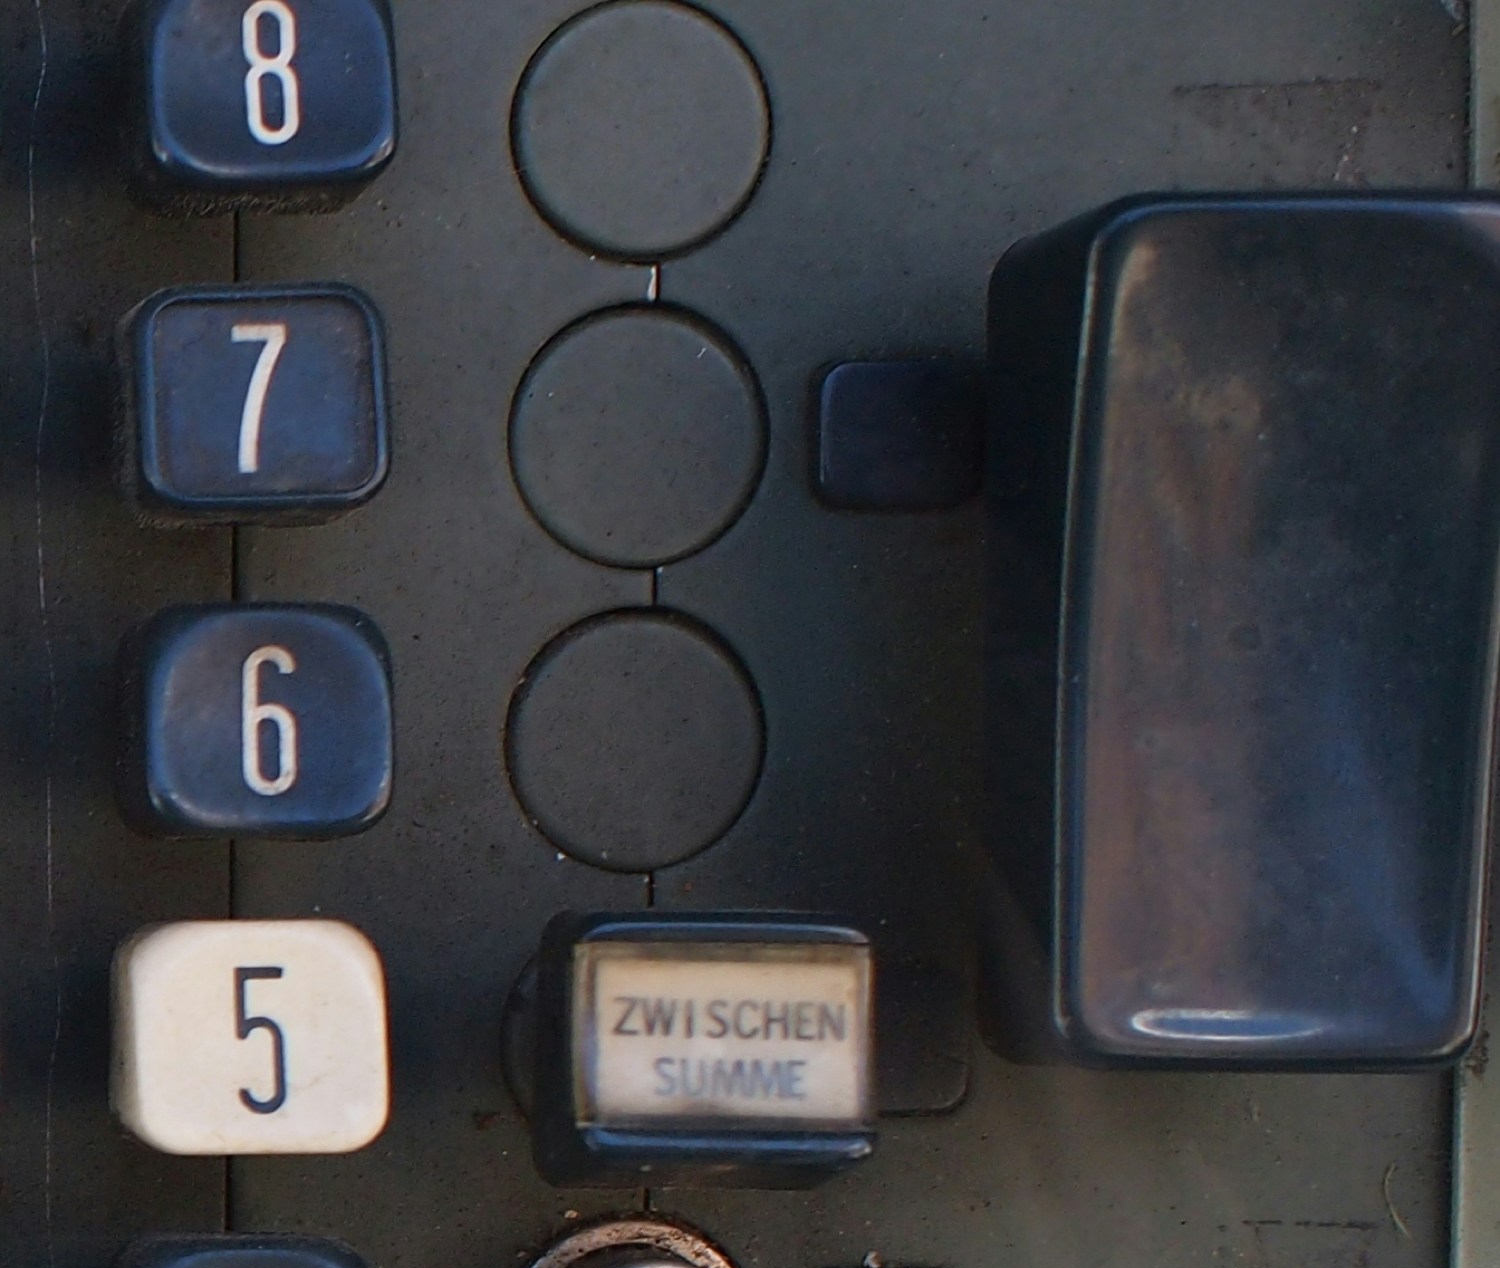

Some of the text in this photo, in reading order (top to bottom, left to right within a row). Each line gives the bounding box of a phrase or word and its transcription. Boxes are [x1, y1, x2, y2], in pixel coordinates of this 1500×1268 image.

[241, 0, 300, 145] 8
[231, 323, 287, 474] 7
[241, 646, 297, 796] 6
[234, 965, 287, 1115] 5
[611, 995, 848, 1042] ZWISCHEN
[653, 1056, 809, 1100] SUMME
